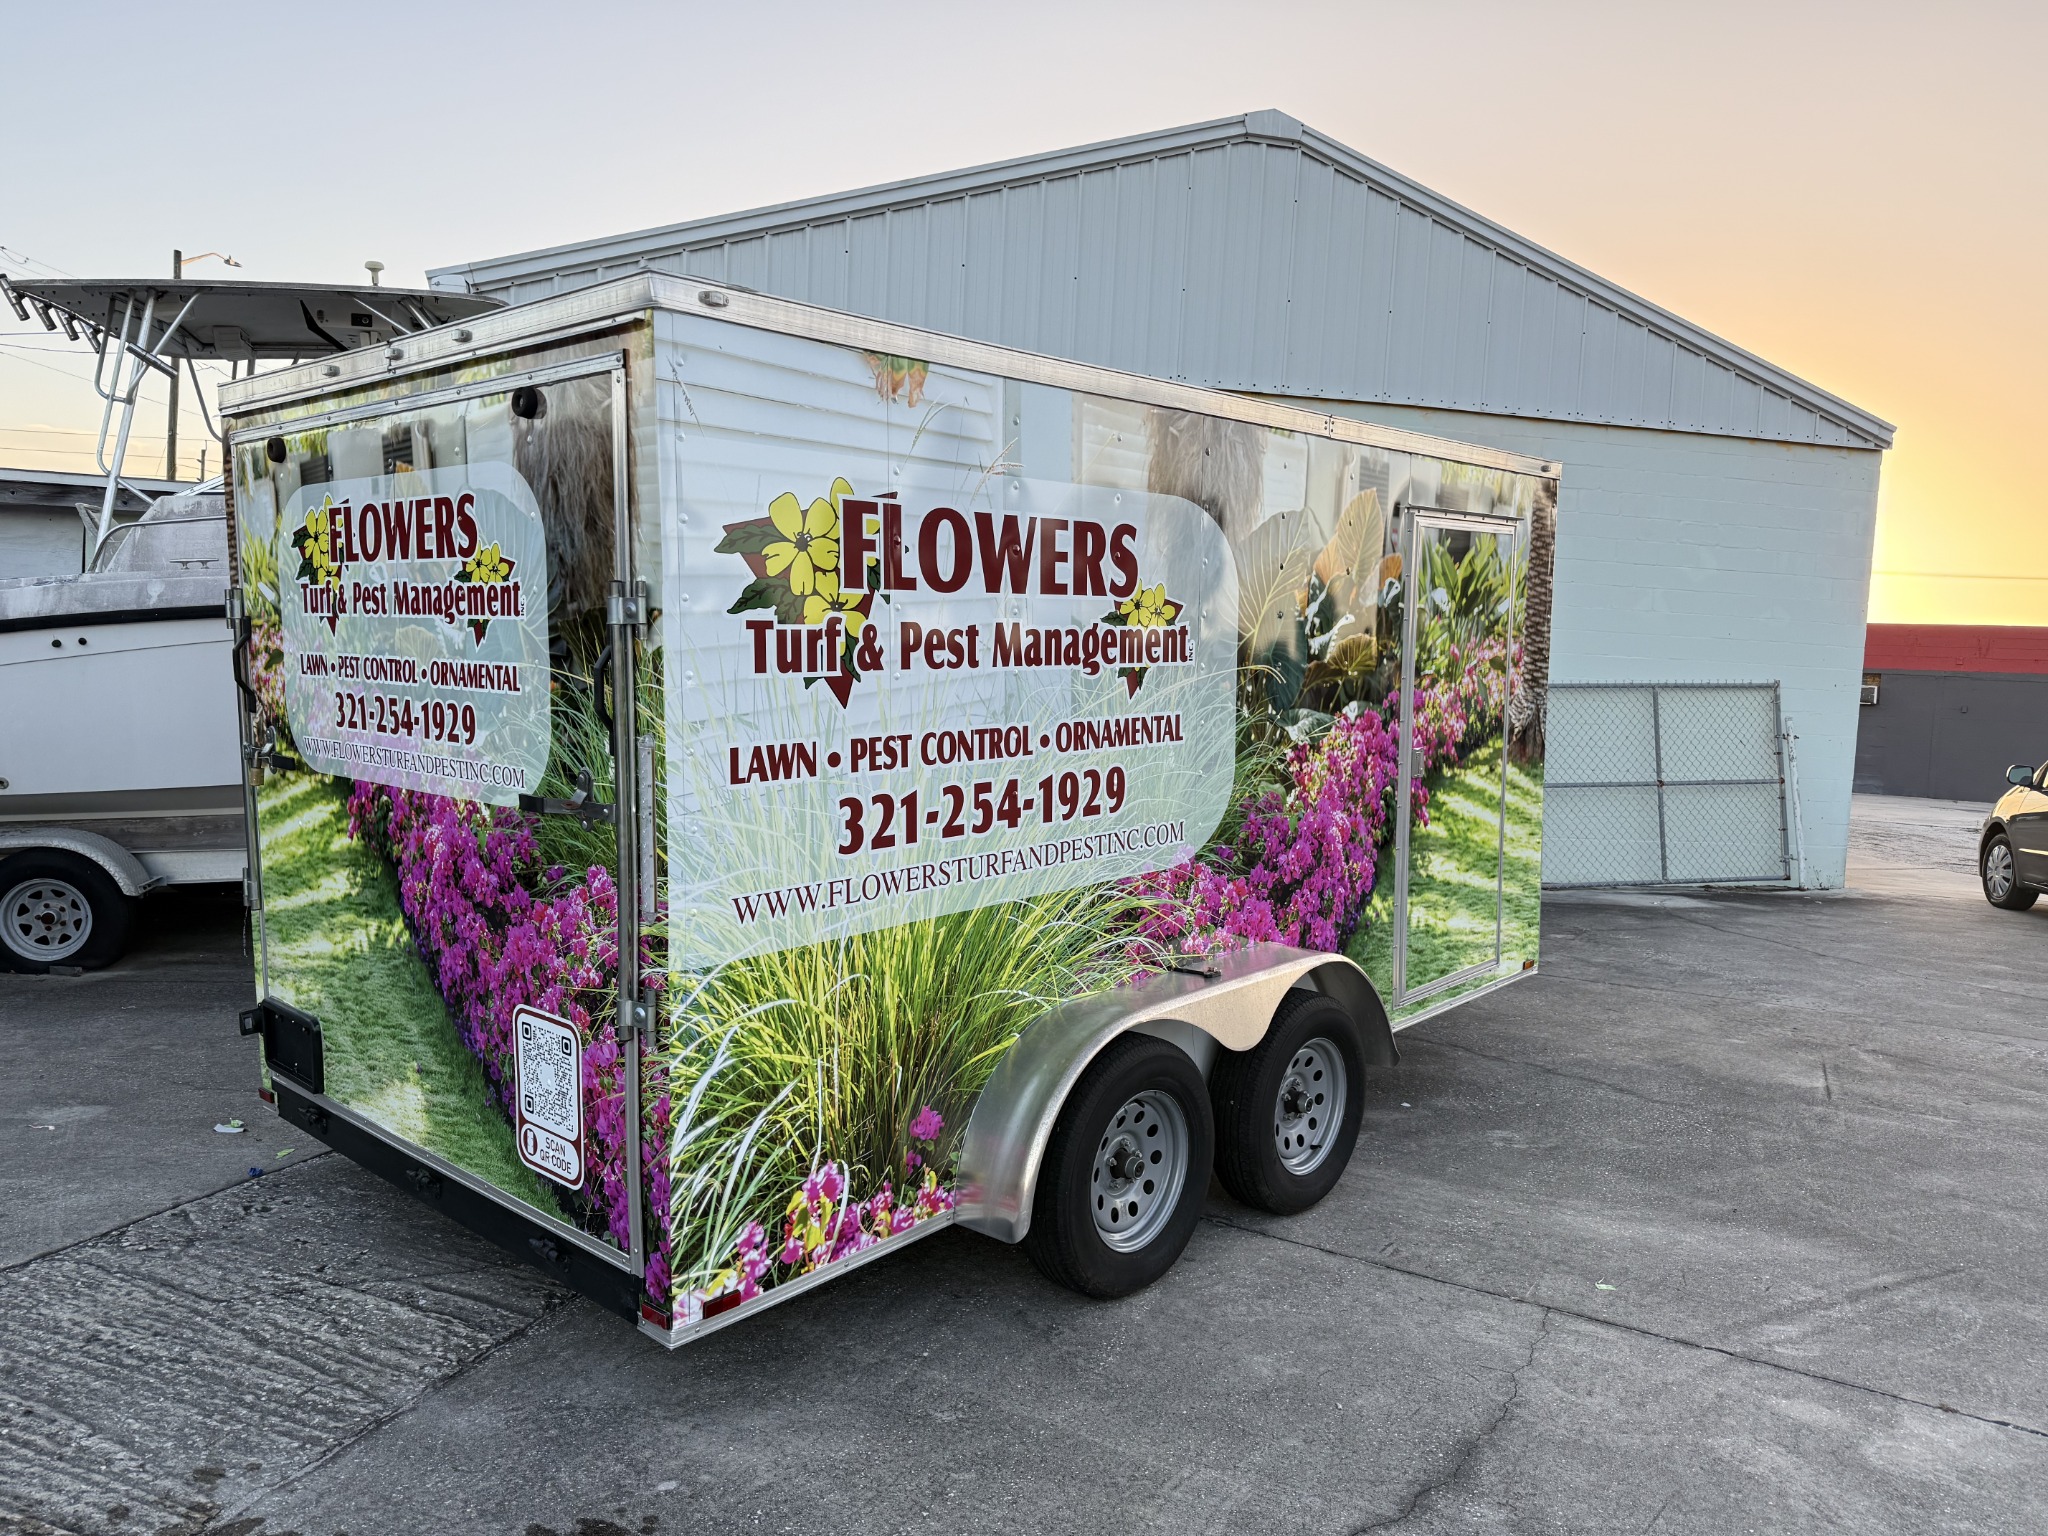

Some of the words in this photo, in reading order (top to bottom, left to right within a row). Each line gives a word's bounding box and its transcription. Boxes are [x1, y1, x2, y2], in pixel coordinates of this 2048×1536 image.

[329, 493, 478, 562] FLOWERS
[842, 498, 1139, 598] FLOWERS
[301, 581, 331, 614] Turf
[338, 586, 347, 613] &
[353, 582, 387, 614] Pest
[394, 581, 520, 624] Management
[300, 654, 327, 676] LAWN
[338, 656, 360, 679] PEST
[363, 656, 418, 684] CONTROL
[430, 661, 520, 692] ORNAMENTAL
[746, 619, 842, 674] Turf
[857, 630, 884, 671] &
[900, 622, 979, 670] Pest
[992, 622, 1188, 675] Management
[335, 692, 476, 745] 321-254-1929
[304, 736, 525, 788] WWW.FLOWERSTURFANDPESTINC.COM
[729, 741, 816, 785] LAWN
[850, 734, 912, 773] PEST
[920, 725, 1033, 766] CONTROL
[1055, 714, 1183, 752] ORNAMENTAL
[837, 766, 1126, 855] 321-254-1929
[731, 821, 1185, 925] WWW.FLOWERSTURFANDPESTINC.COM
[540, 1149, 551, 1163] QR
[551, 1155, 572, 1175] CODE
[545, 1137, 566, 1157] SCAN
